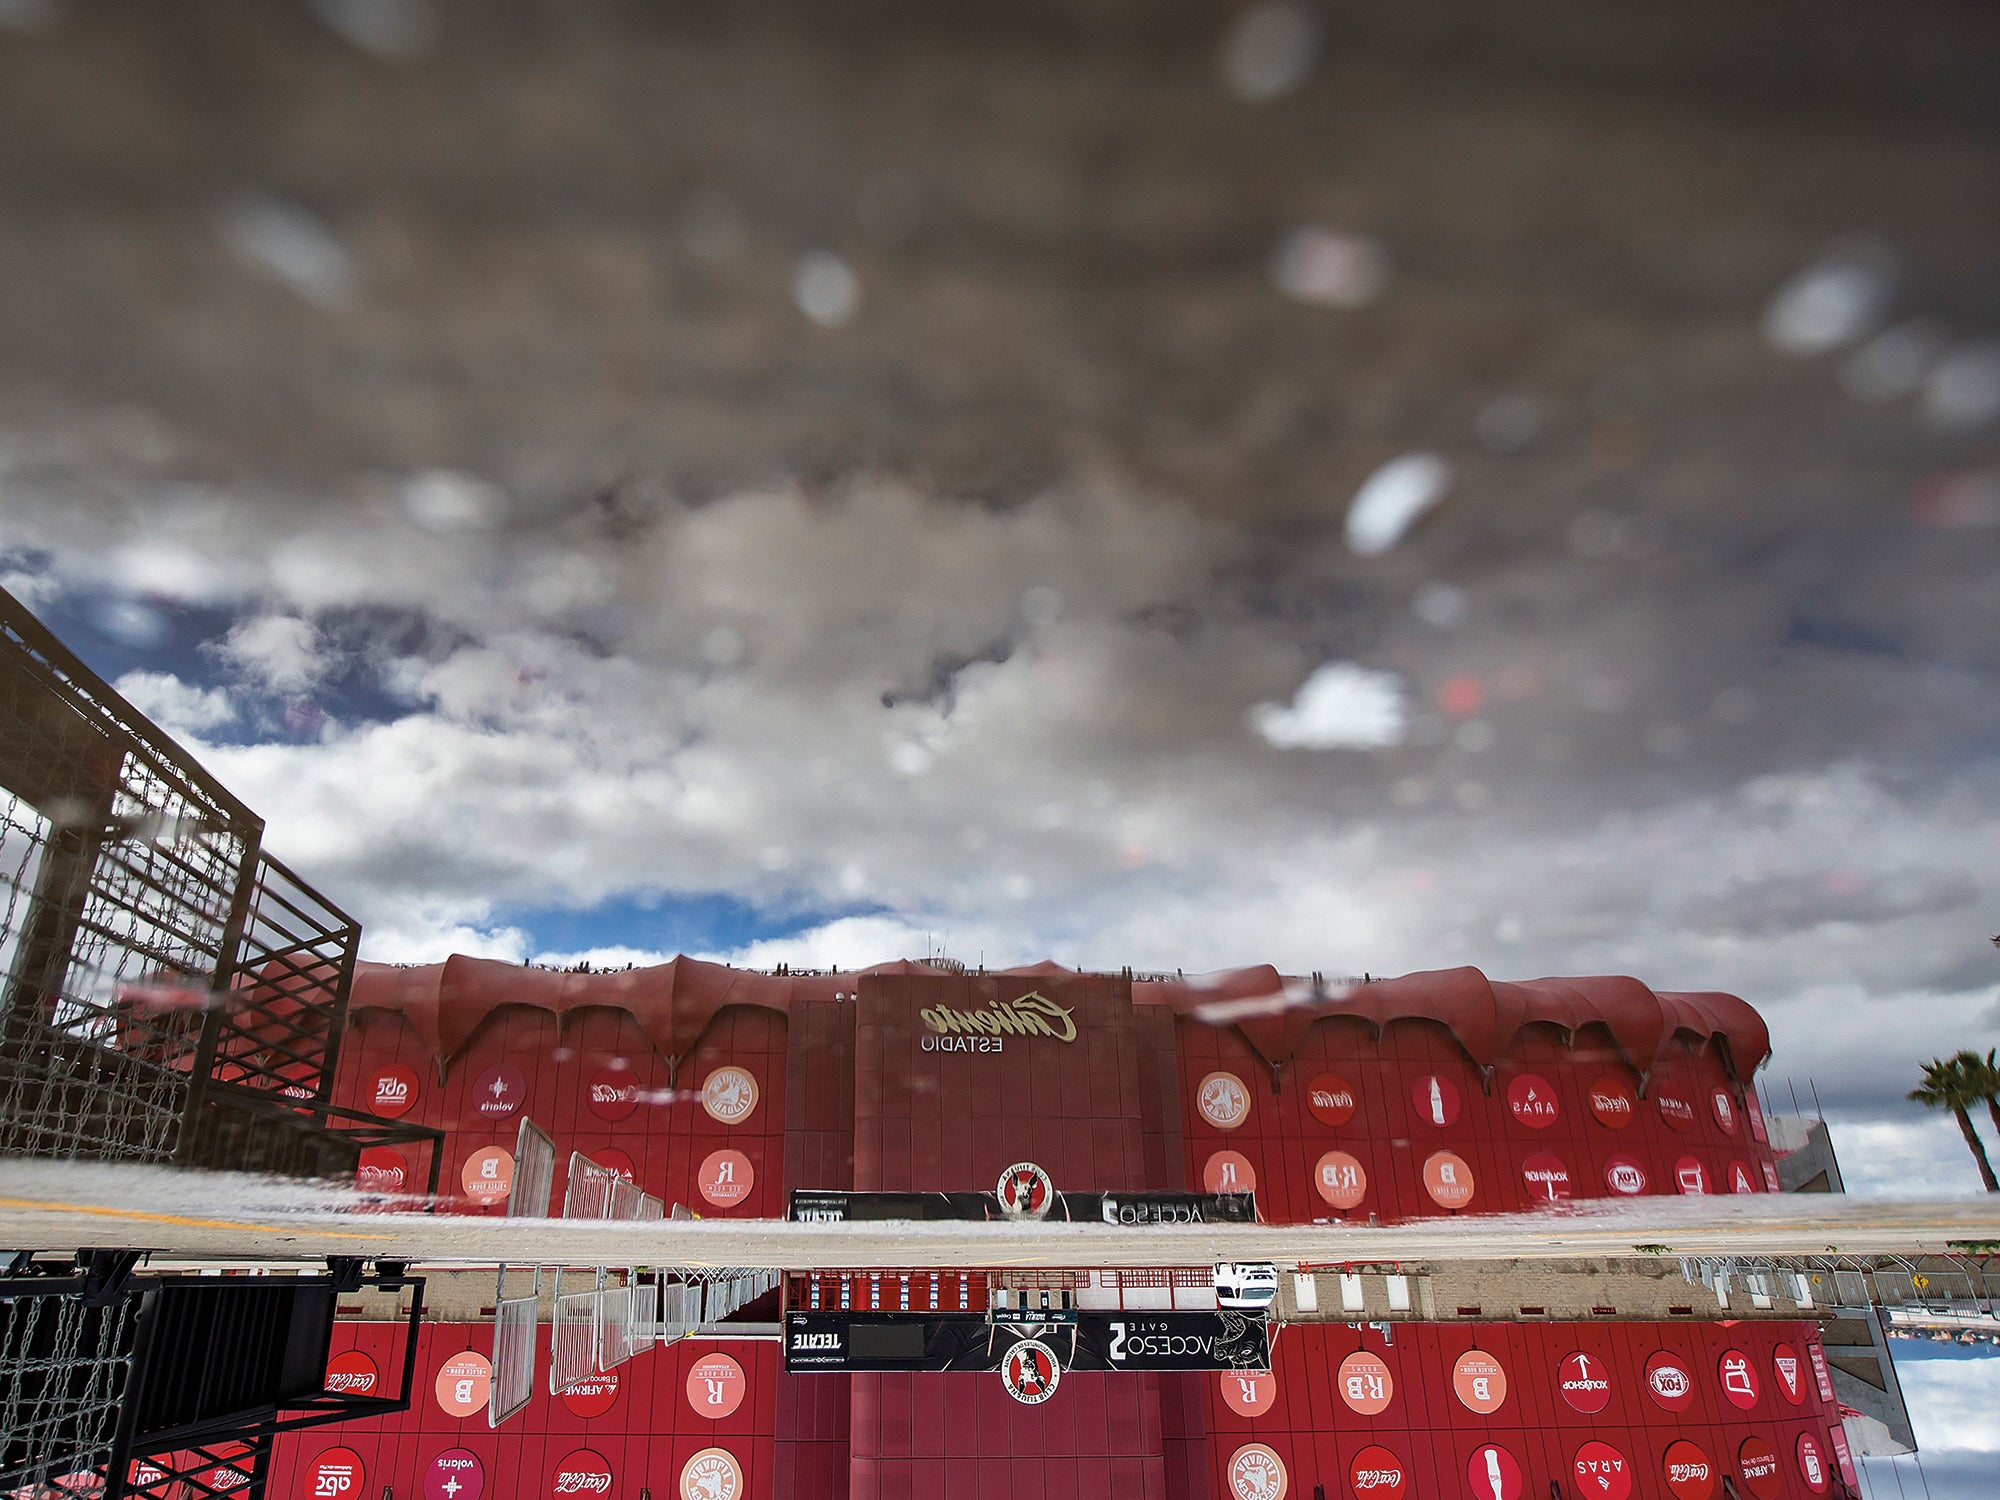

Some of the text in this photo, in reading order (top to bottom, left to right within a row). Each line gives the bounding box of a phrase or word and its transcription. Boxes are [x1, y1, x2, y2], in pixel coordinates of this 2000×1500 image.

[1129, 1322, 1168, 1331] GATE
[791, 1333, 842, 1350] TECATE
[1109, 1322, 1213, 1360] ACCESO 2
[324, 1373, 375, 1392] Coca-Cola
[590, 1376, 611, 1384] Banco
[1472, 1377, 1491, 1400] B
[1659, 1378, 1682, 1391] FOX
[454, 1380, 474, 1404] B
[565, 1384, 604, 1396] AFIRME
[704, 1378, 725, 1405] R
[1008, 1383, 1056, 1402] CLUB TIJUANA
[1236, 1377, 1258, 1403] R
[438, 1459, 473, 1471] volaris
[690, 1459, 732, 1480] TIJUANA
[1236, 1455, 1277, 1476] TIJUANA
[1577, 1460, 1622, 1474] ARAS
[1668, 1463, 1708, 1482] Coca-Cola
[315, 1475, 351, 1496] abc
[554, 1471, 611, 1493] Coca-Cola
[1356, 1469, 1401, 1488] Coca-Cola
